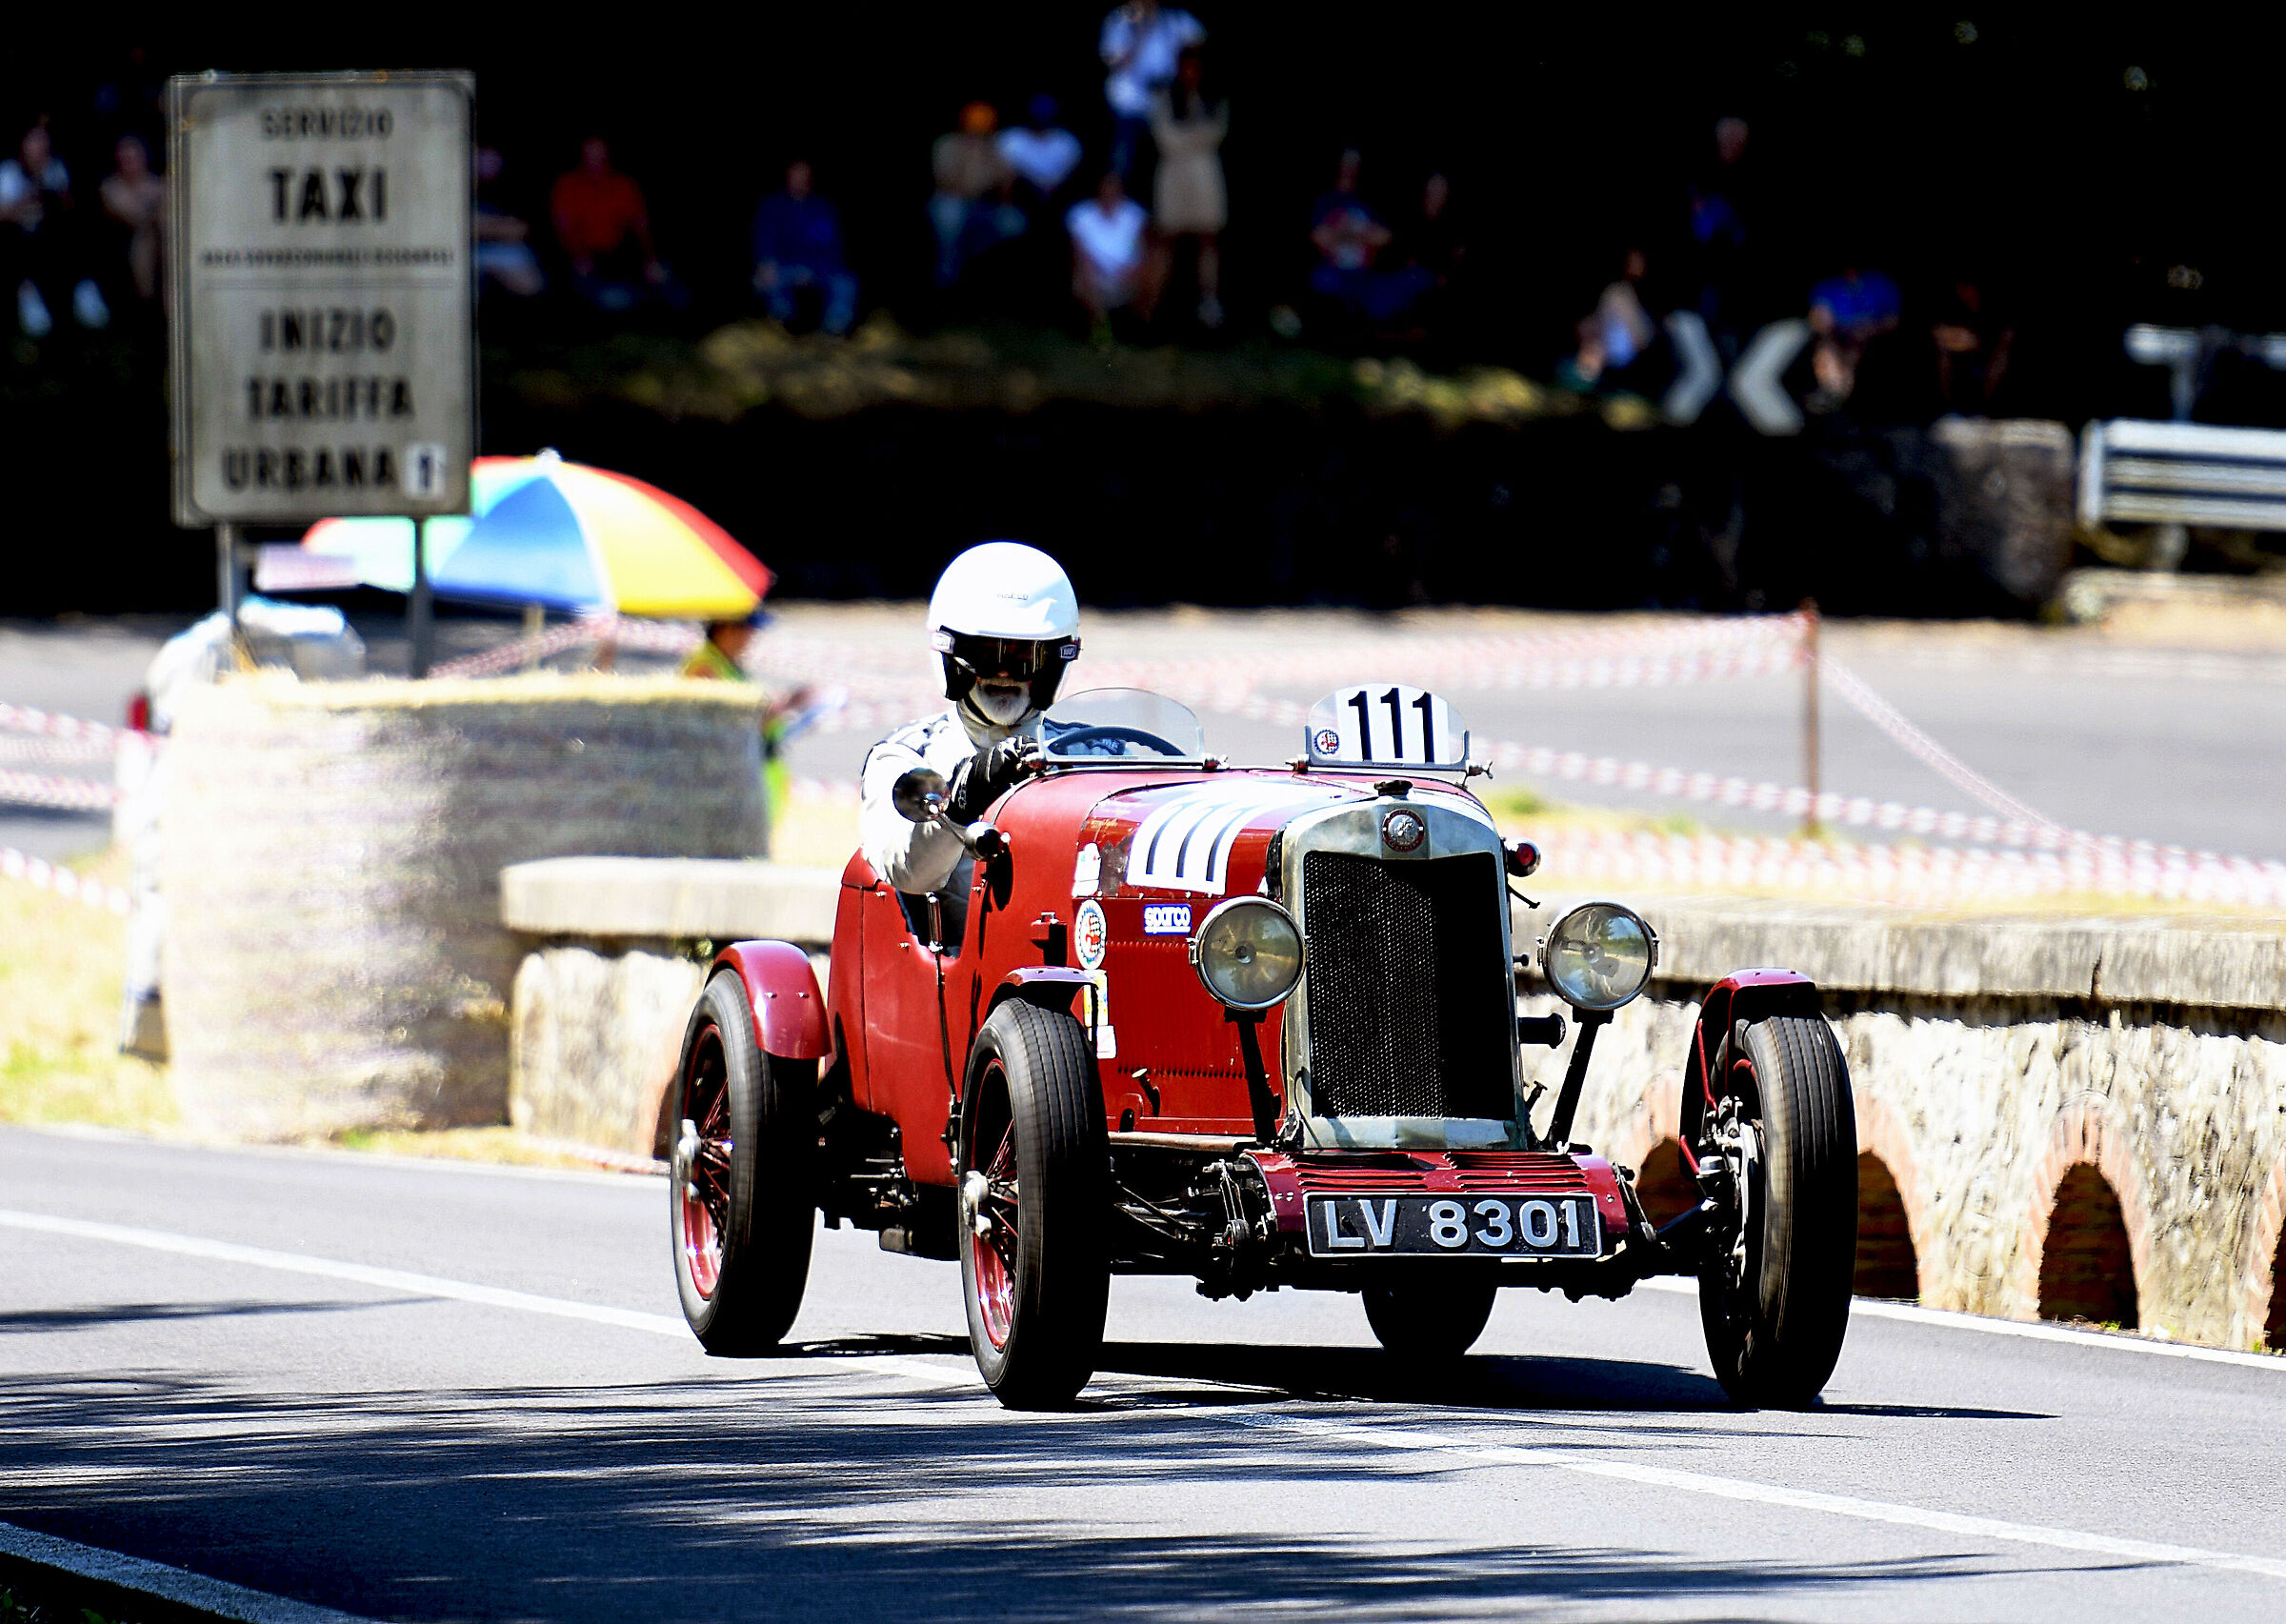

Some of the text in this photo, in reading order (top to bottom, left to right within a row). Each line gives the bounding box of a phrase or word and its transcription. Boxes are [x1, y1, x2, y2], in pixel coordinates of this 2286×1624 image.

[261, 109, 392, 139] SERVIZIO
[270, 166, 389, 223] TAXI
[258, 307, 396, 354] INIZIO
[246, 377, 415, 422] TARIFFA
[221, 444, 399, 493] URBANA
[1348, 688, 1435, 763] 111
[1323, 1198, 1581, 1250] LV 8301
